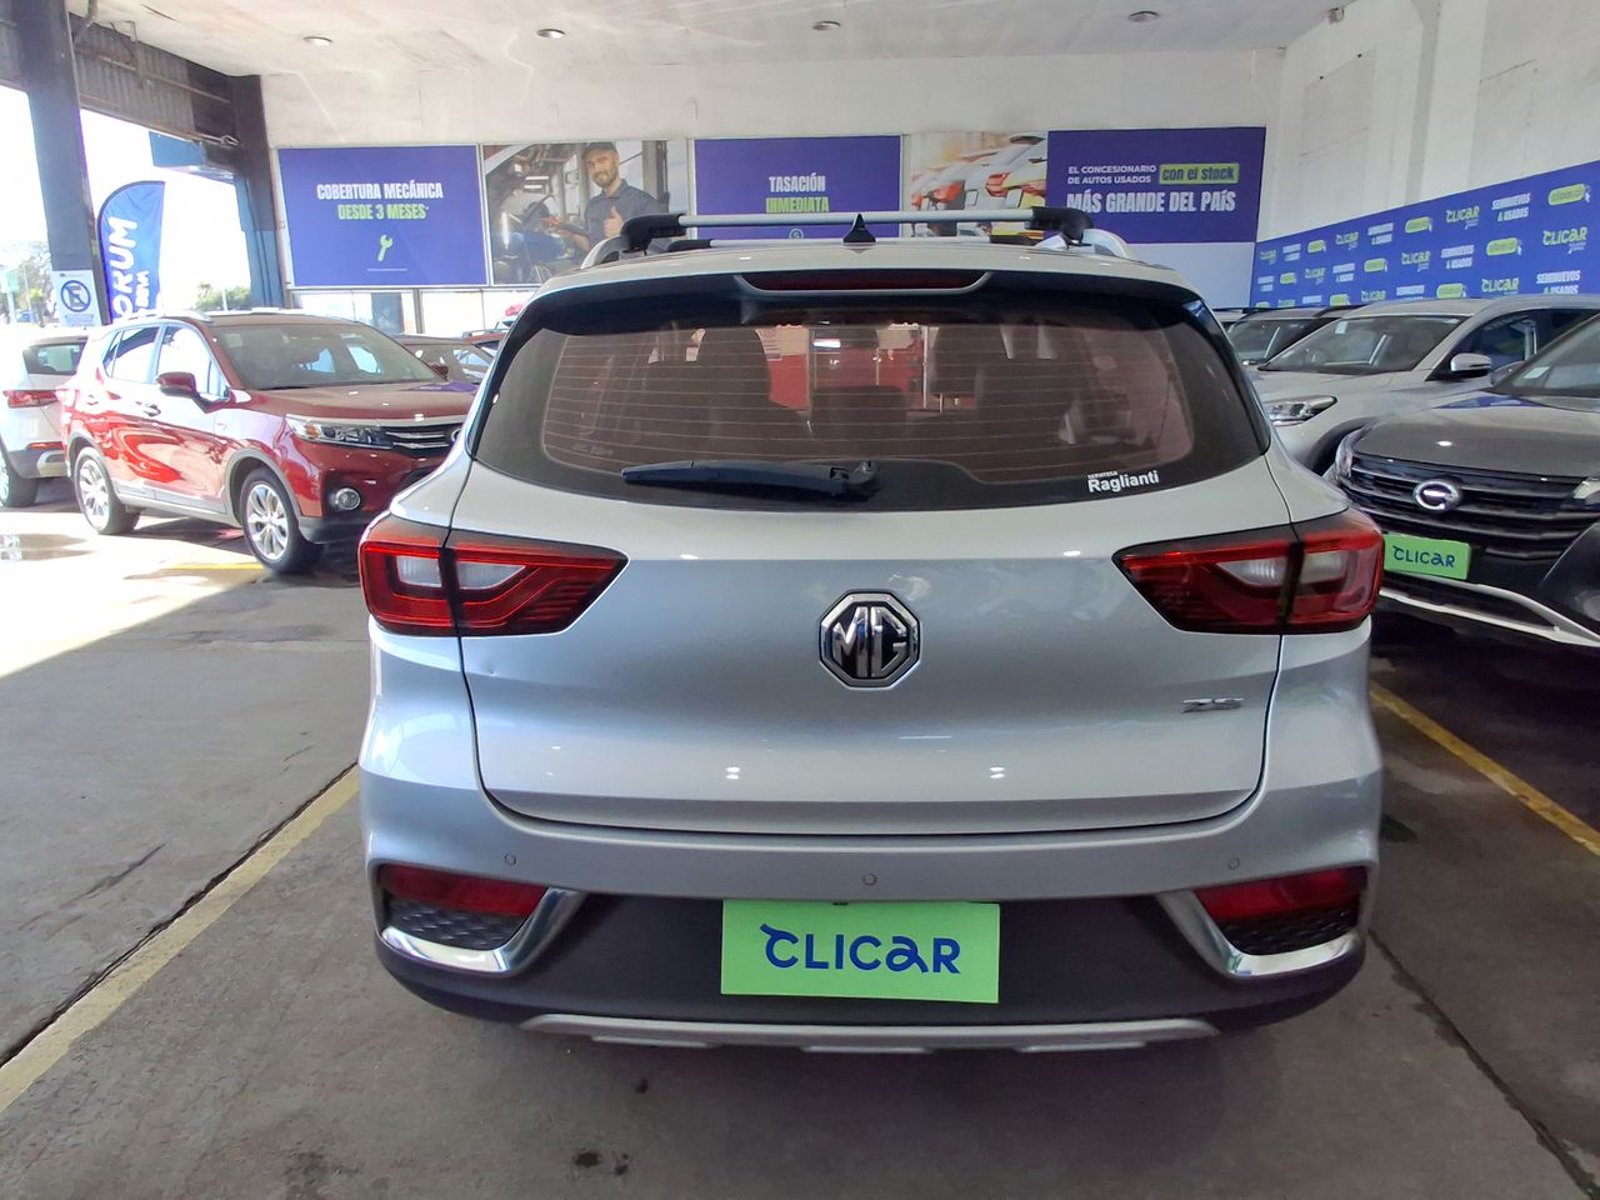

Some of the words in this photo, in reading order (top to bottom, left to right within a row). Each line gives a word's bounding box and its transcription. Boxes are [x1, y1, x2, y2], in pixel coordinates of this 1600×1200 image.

[768, 172, 826, 193] TASACIÓN
[1067, 176, 1080, 185] DE
[1082, 176, 1112, 185] AUTOS
[1114, 175, 1151, 184] USADOS
[1068, 166, 1080, 174] EL
[1081, 165, 1157, 174] CONCESIONARIO
[1162, 168, 1184, 181] con
[1187, 167, 1198, 181] el
[1201, 166, 1234, 181] stock
[317, 183, 382, 200] COBERTURA
[384, 179, 444, 199] MECÁNICA
[337, 204, 374, 220] DESDE
[375, 204, 384, 219] 3
[1066, 189, 1102, 214] MÁS
[1105, 191, 1165, 214] GRANDE
[1169, 191, 1197, 213] DEL
[1445, 205, 1480, 223] CLICAR
[1543, 226, 1588, 245] CLICAR
[108, 215, 137, 318] ORUM
[1481, 277, 1519, 293] CLICAR
[1087, 470, 1159, 493] Raglianti
[1392, 545, 1456, 568] CLICAR
[831, 605, 909, 679] MG
[759, 923, 961, 974] CLICAR
